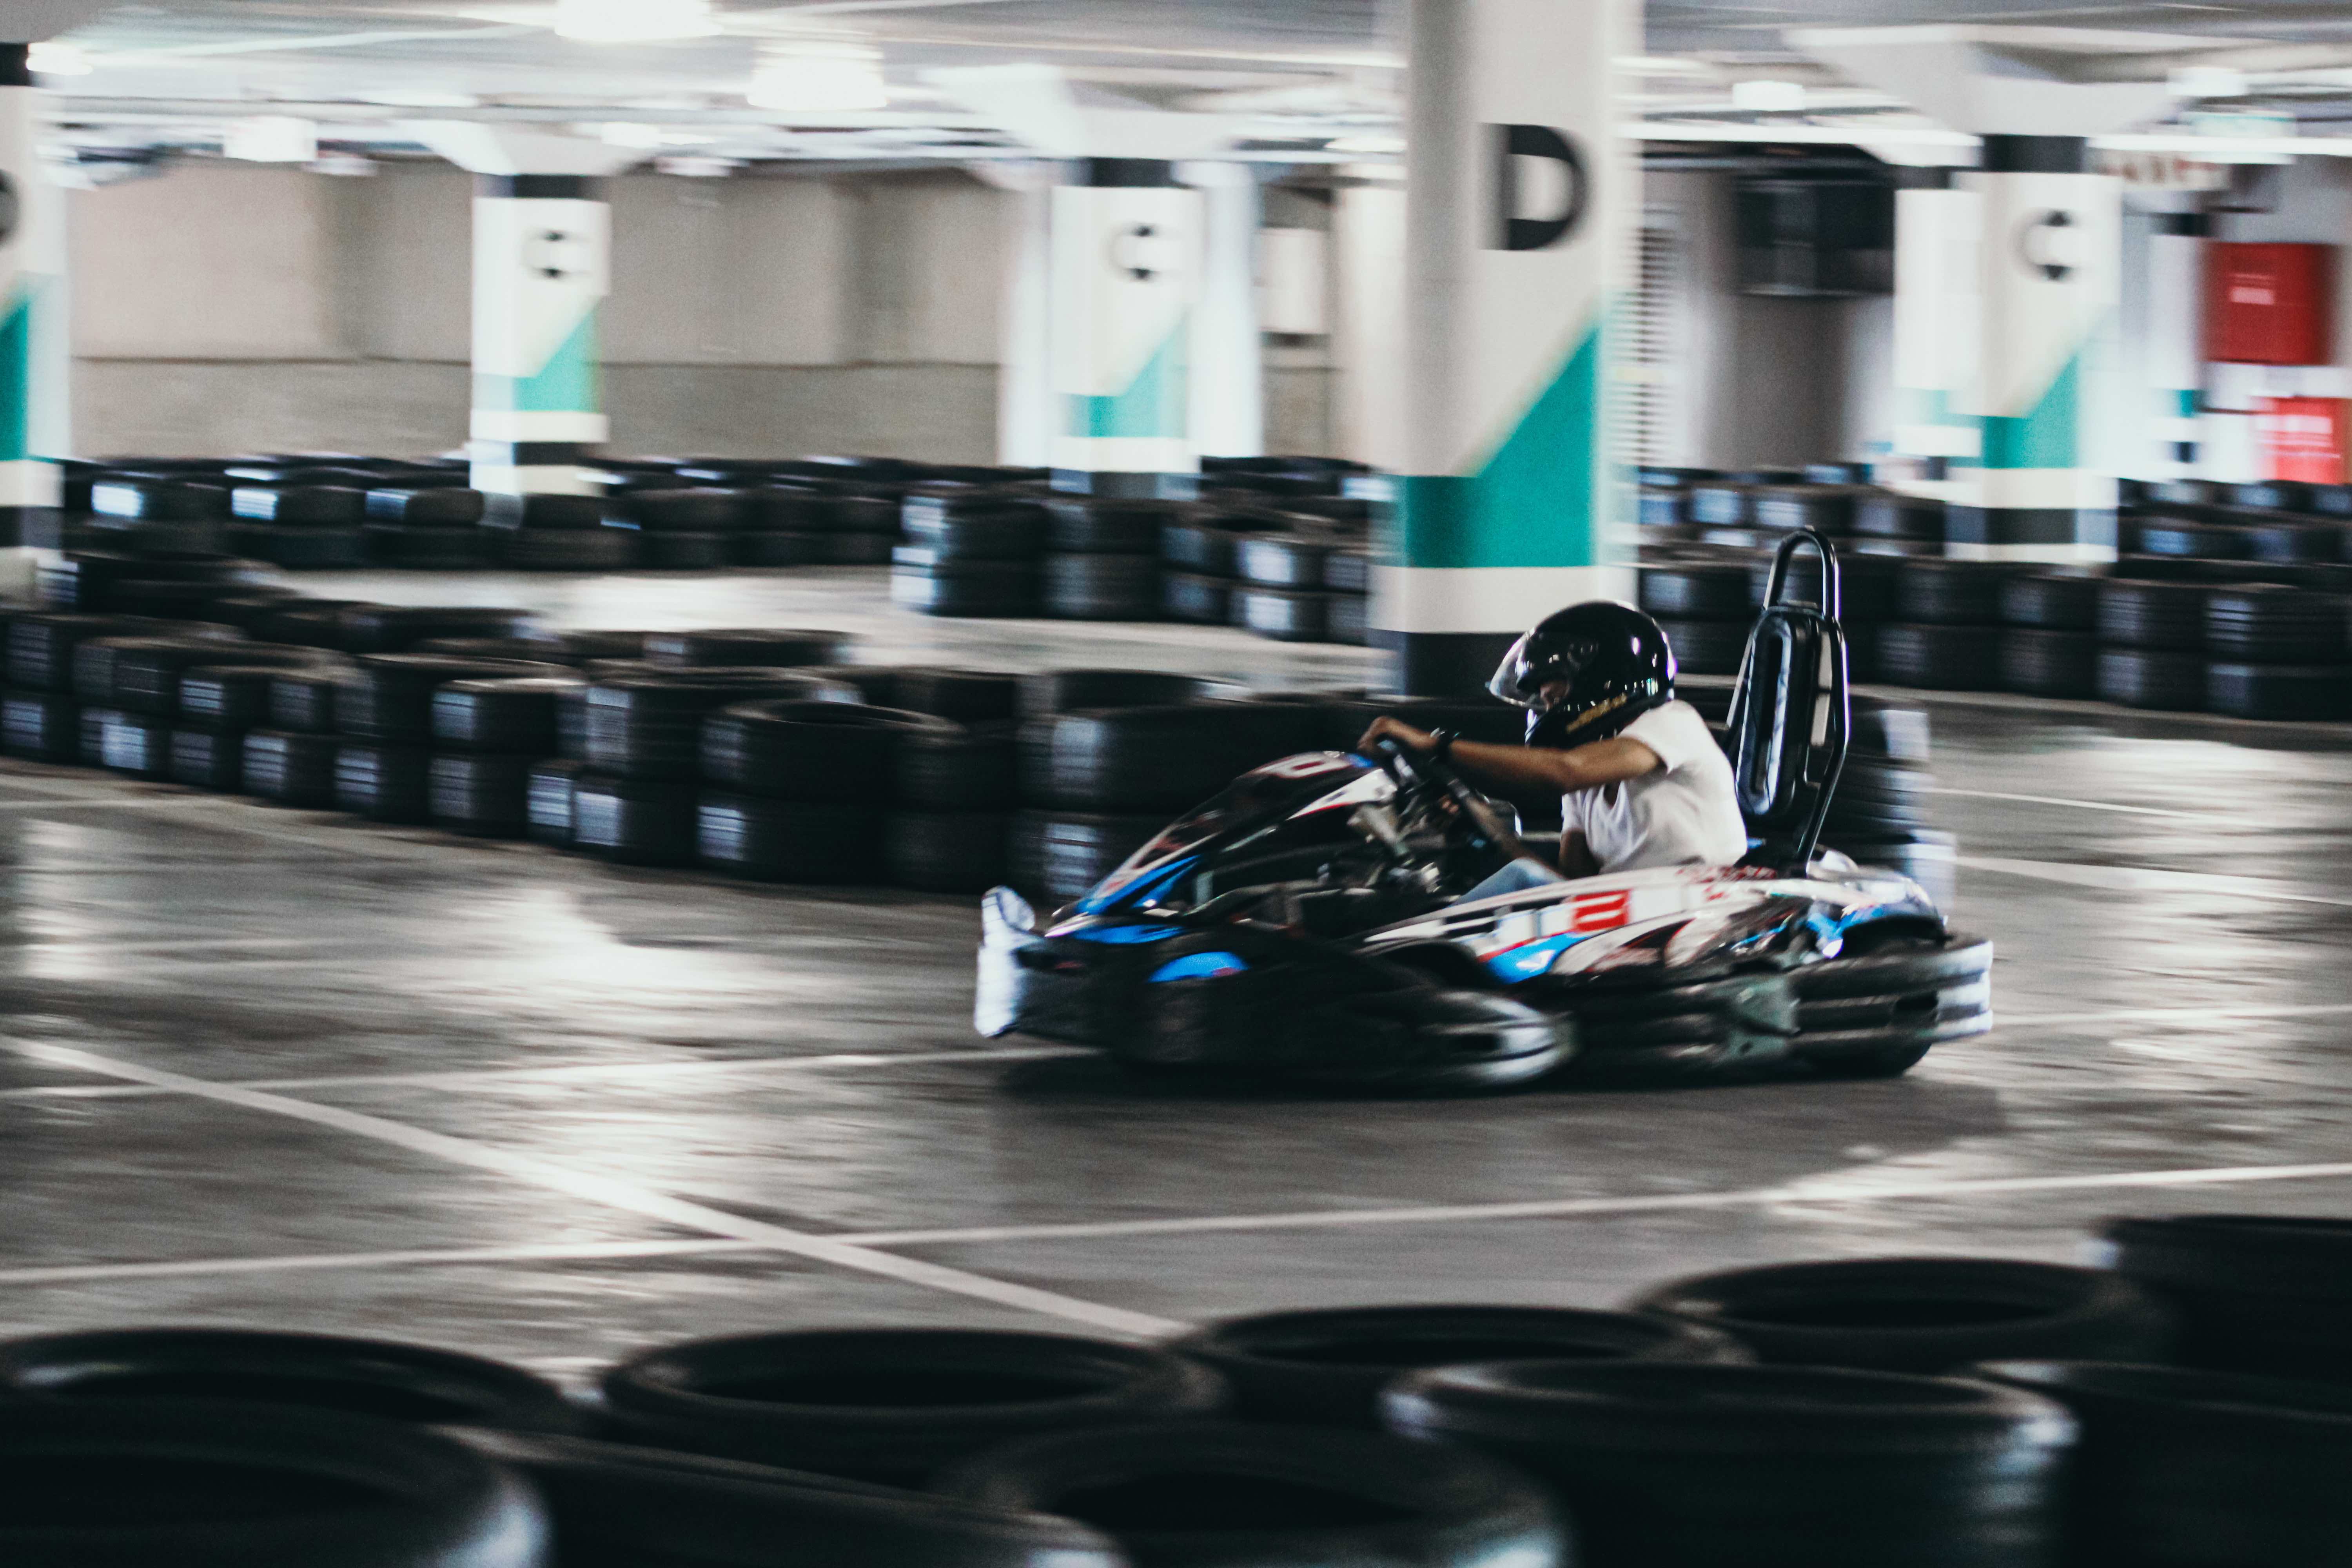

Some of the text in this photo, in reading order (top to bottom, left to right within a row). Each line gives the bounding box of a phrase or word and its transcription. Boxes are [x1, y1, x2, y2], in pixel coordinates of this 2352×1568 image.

[1486, 123, 1592, 251] D
[1101, 221, 1158, 283] C
[2010, 208, 2077, 283] C
